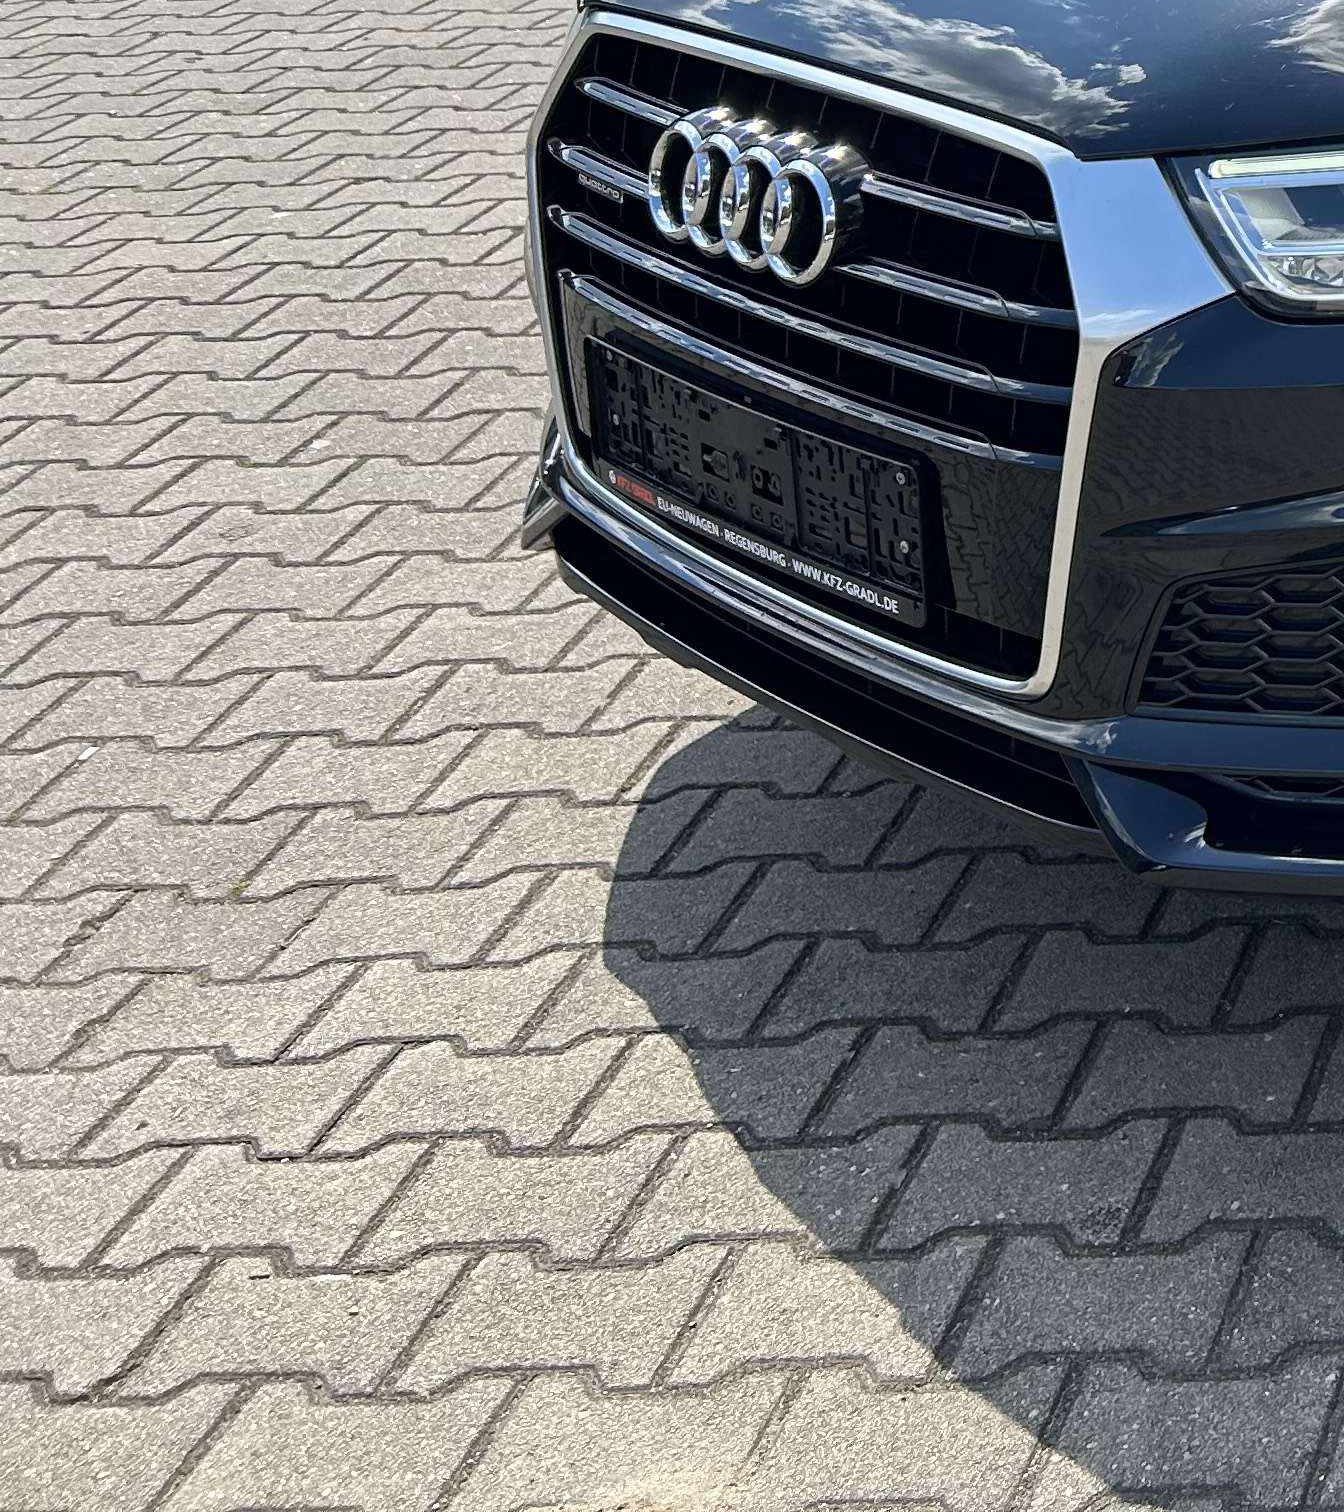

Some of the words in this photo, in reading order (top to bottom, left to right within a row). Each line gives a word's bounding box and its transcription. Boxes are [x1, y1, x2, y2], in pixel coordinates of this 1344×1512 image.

[578, 173, 620, 199] quattro
[656, 496, 720, 537] EU-NEUWAGEN
[723, 528, 787, 568] REGENSBURG
[791, 558, 900, 615] WWW.KFZ-GRADL.DE
